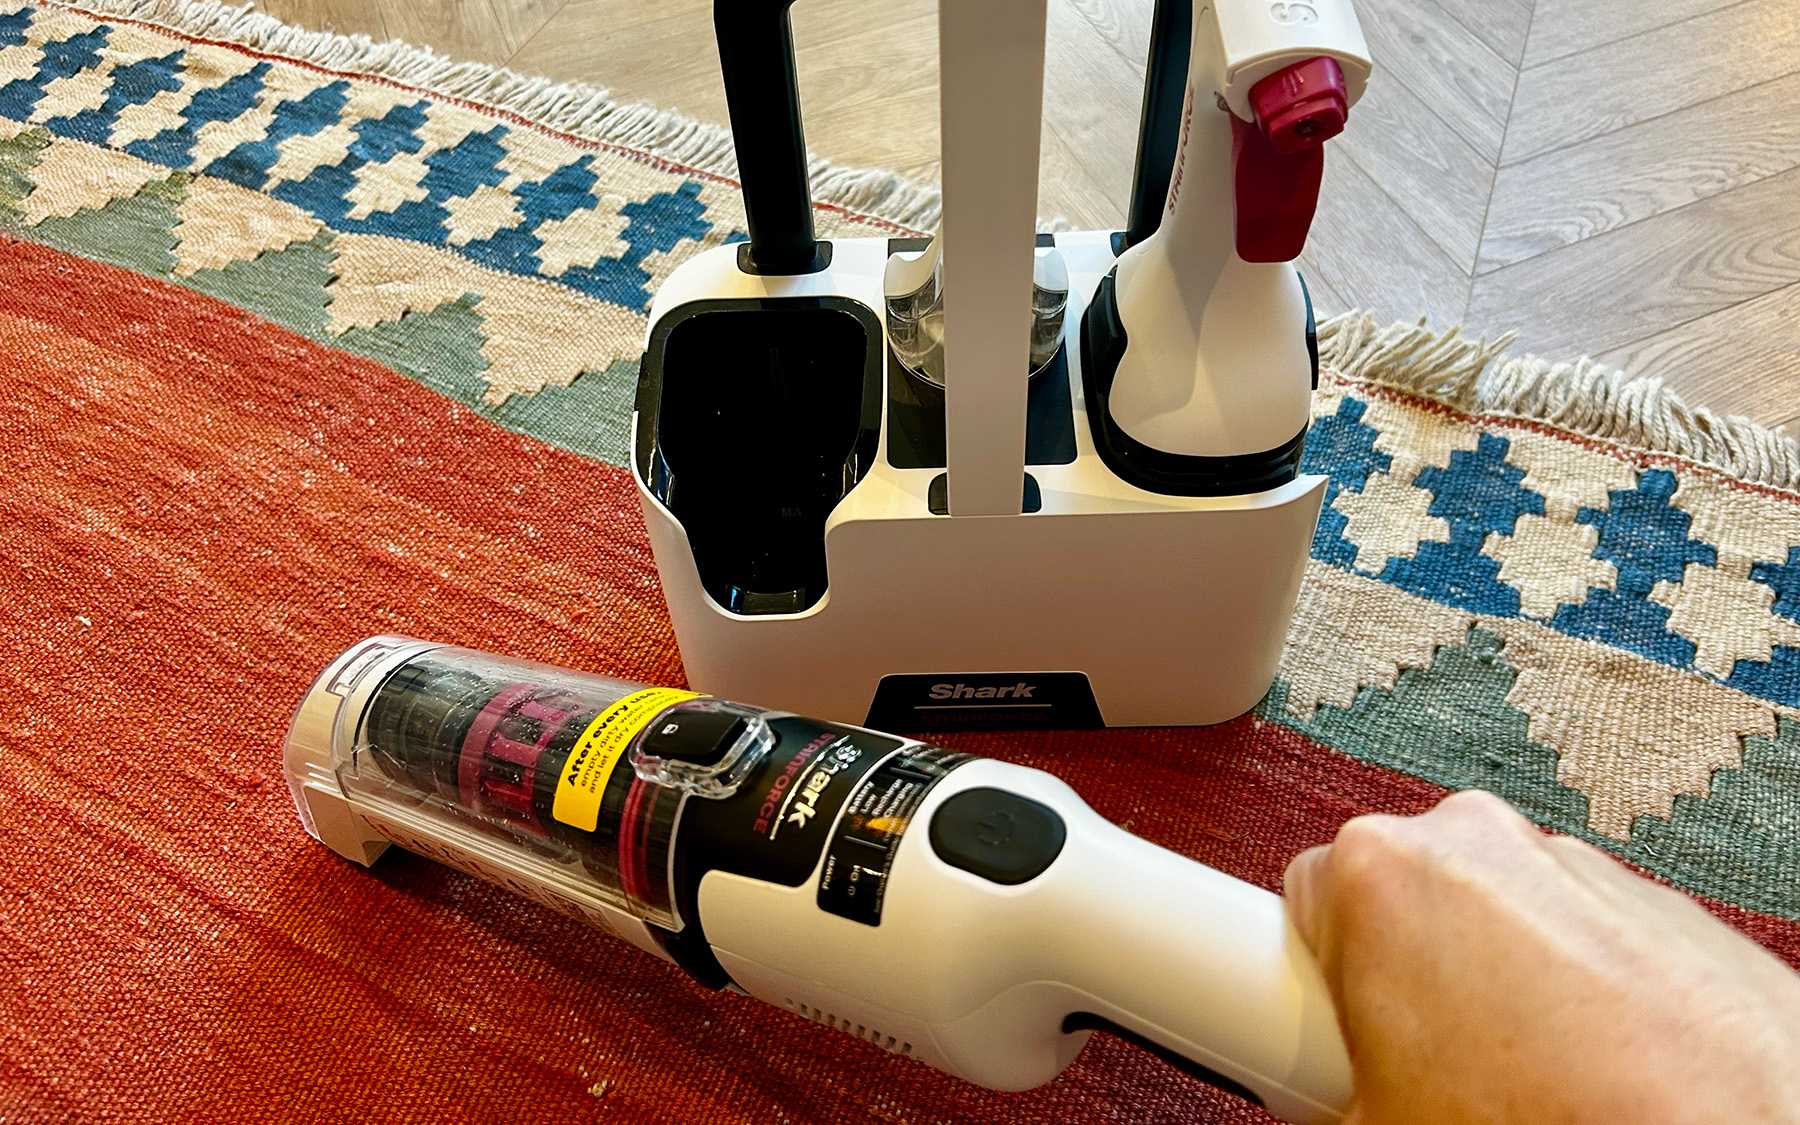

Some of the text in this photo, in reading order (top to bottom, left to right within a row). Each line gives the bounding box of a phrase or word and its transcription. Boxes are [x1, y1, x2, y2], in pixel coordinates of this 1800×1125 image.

[928, 682, 1038, 700] Shark
[568, 741, 593, 786] After
[592, 704, 628, 738] every
[581, 750, 601, 787] empty
[600, 725, 619, 748] dirty
[589, 771, 601, 793] and
[597, 754, 610, 769] let
[614, 726, 629, 743] dry
[753, 733, 836, 834] STAINFORCE
[787, 744, 863, 829] Shark
[848, 781, 875, 815] Battery
[860, 793, 878, 814] Low
[884, 783, 914, 817] Charging
[821, 854, 837, 891] Power
